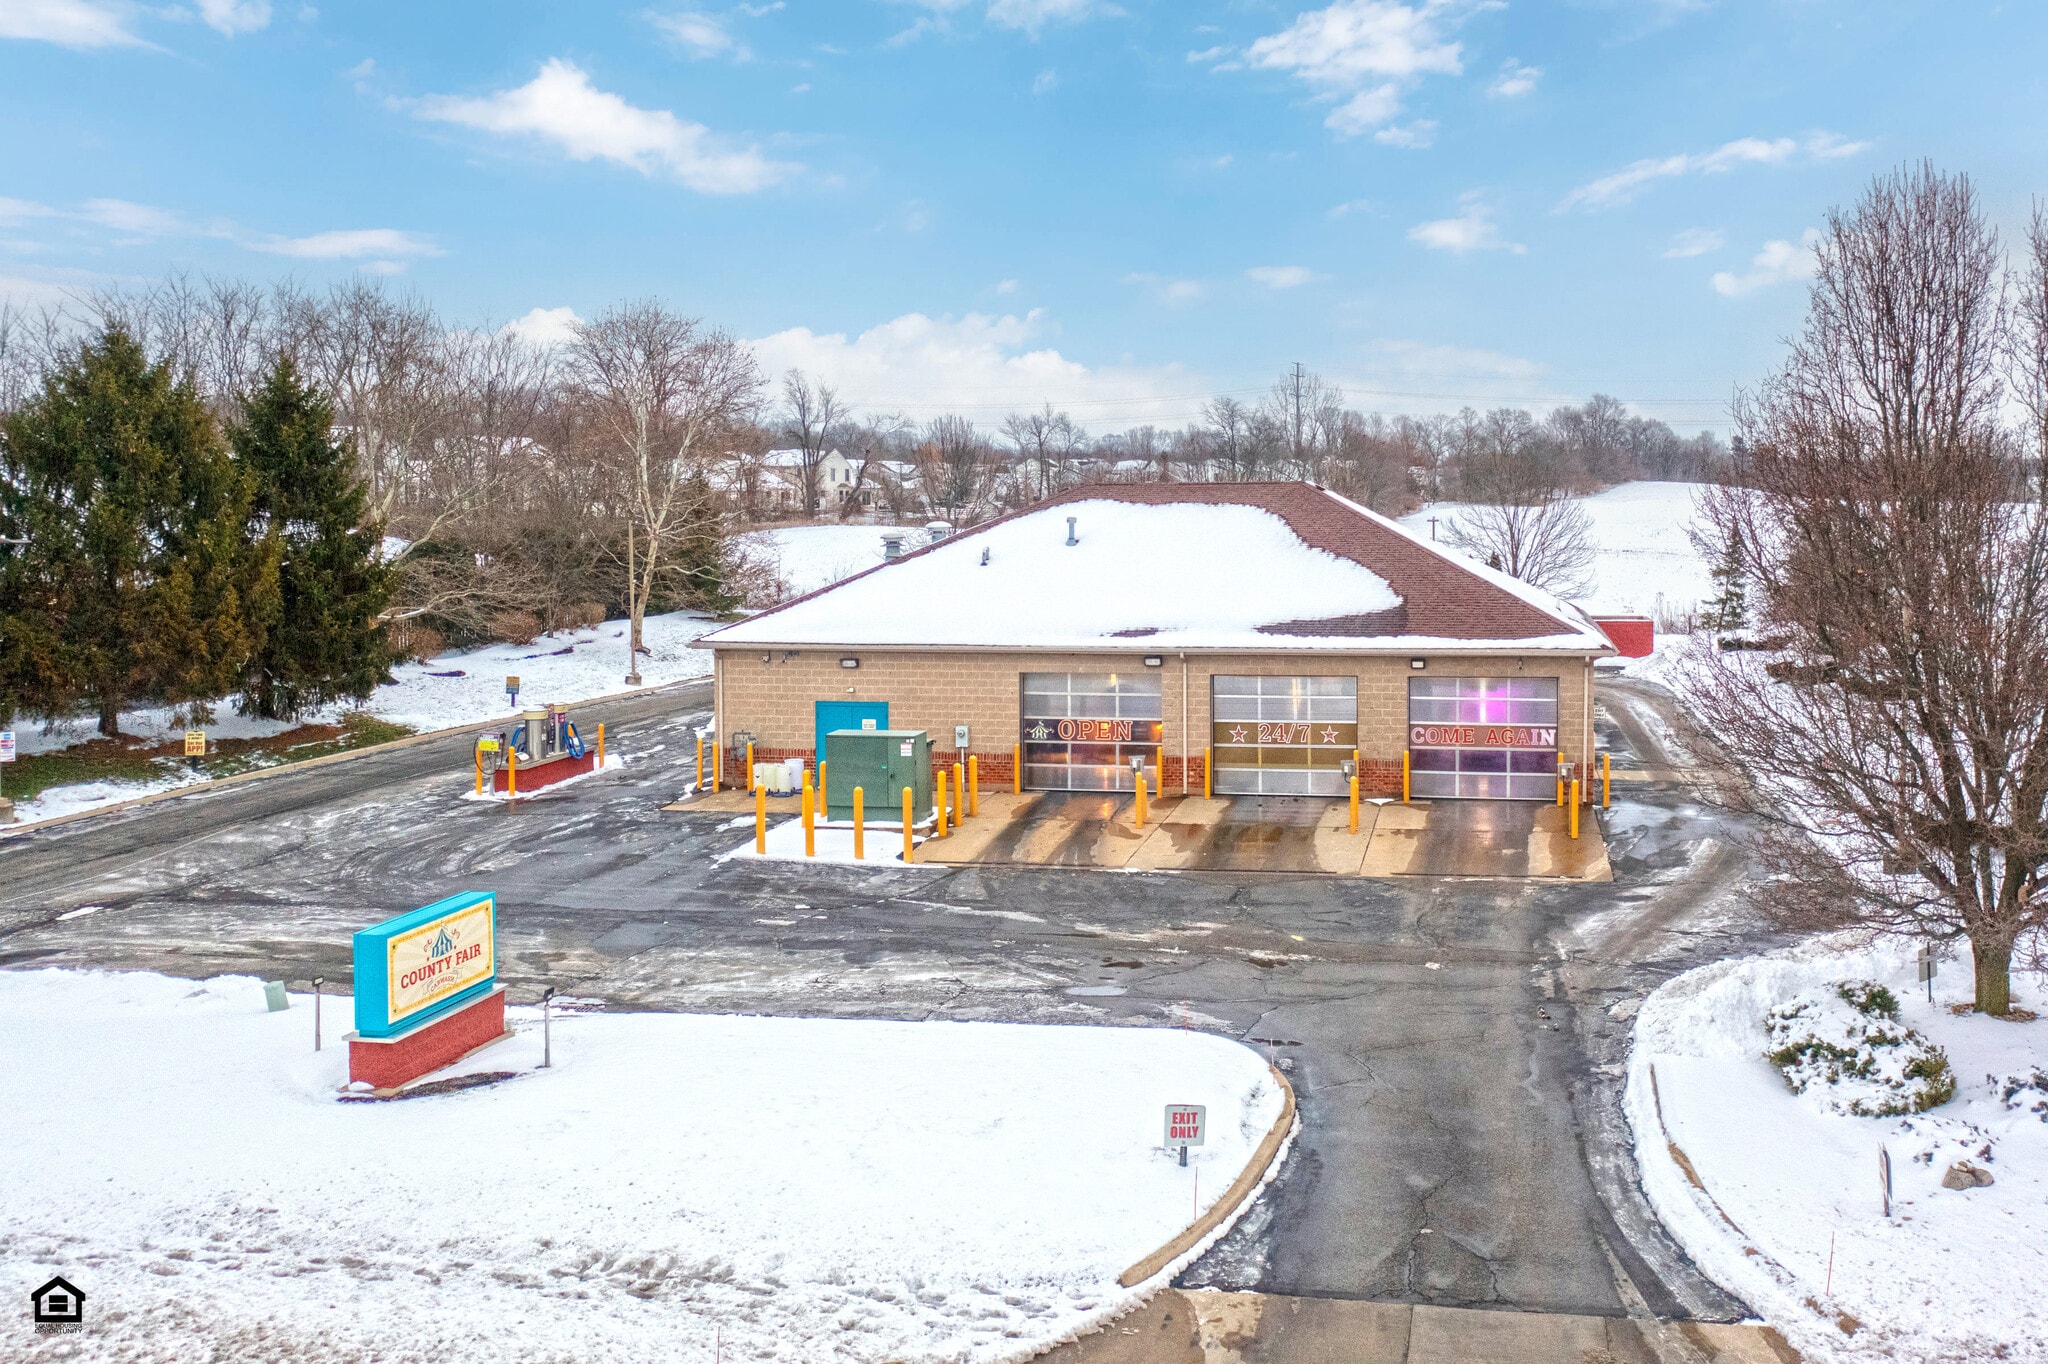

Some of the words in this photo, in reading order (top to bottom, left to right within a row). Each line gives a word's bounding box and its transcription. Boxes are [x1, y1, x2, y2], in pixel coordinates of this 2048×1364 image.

[1058, 719, 1132, 741] OPEN
[1258, 723, 1311, 743] 24/7
[1411, 727, 1474, 744] COME
[1485, 728, 1556, 745] AGAIN
[401, 956, 452, 989] COUNTY
[455, 943, 481, 968] FAIR
[1172, 1112, 1198, 1124] EXIT
[1170, 1126, 1199, 1138] ONLY
